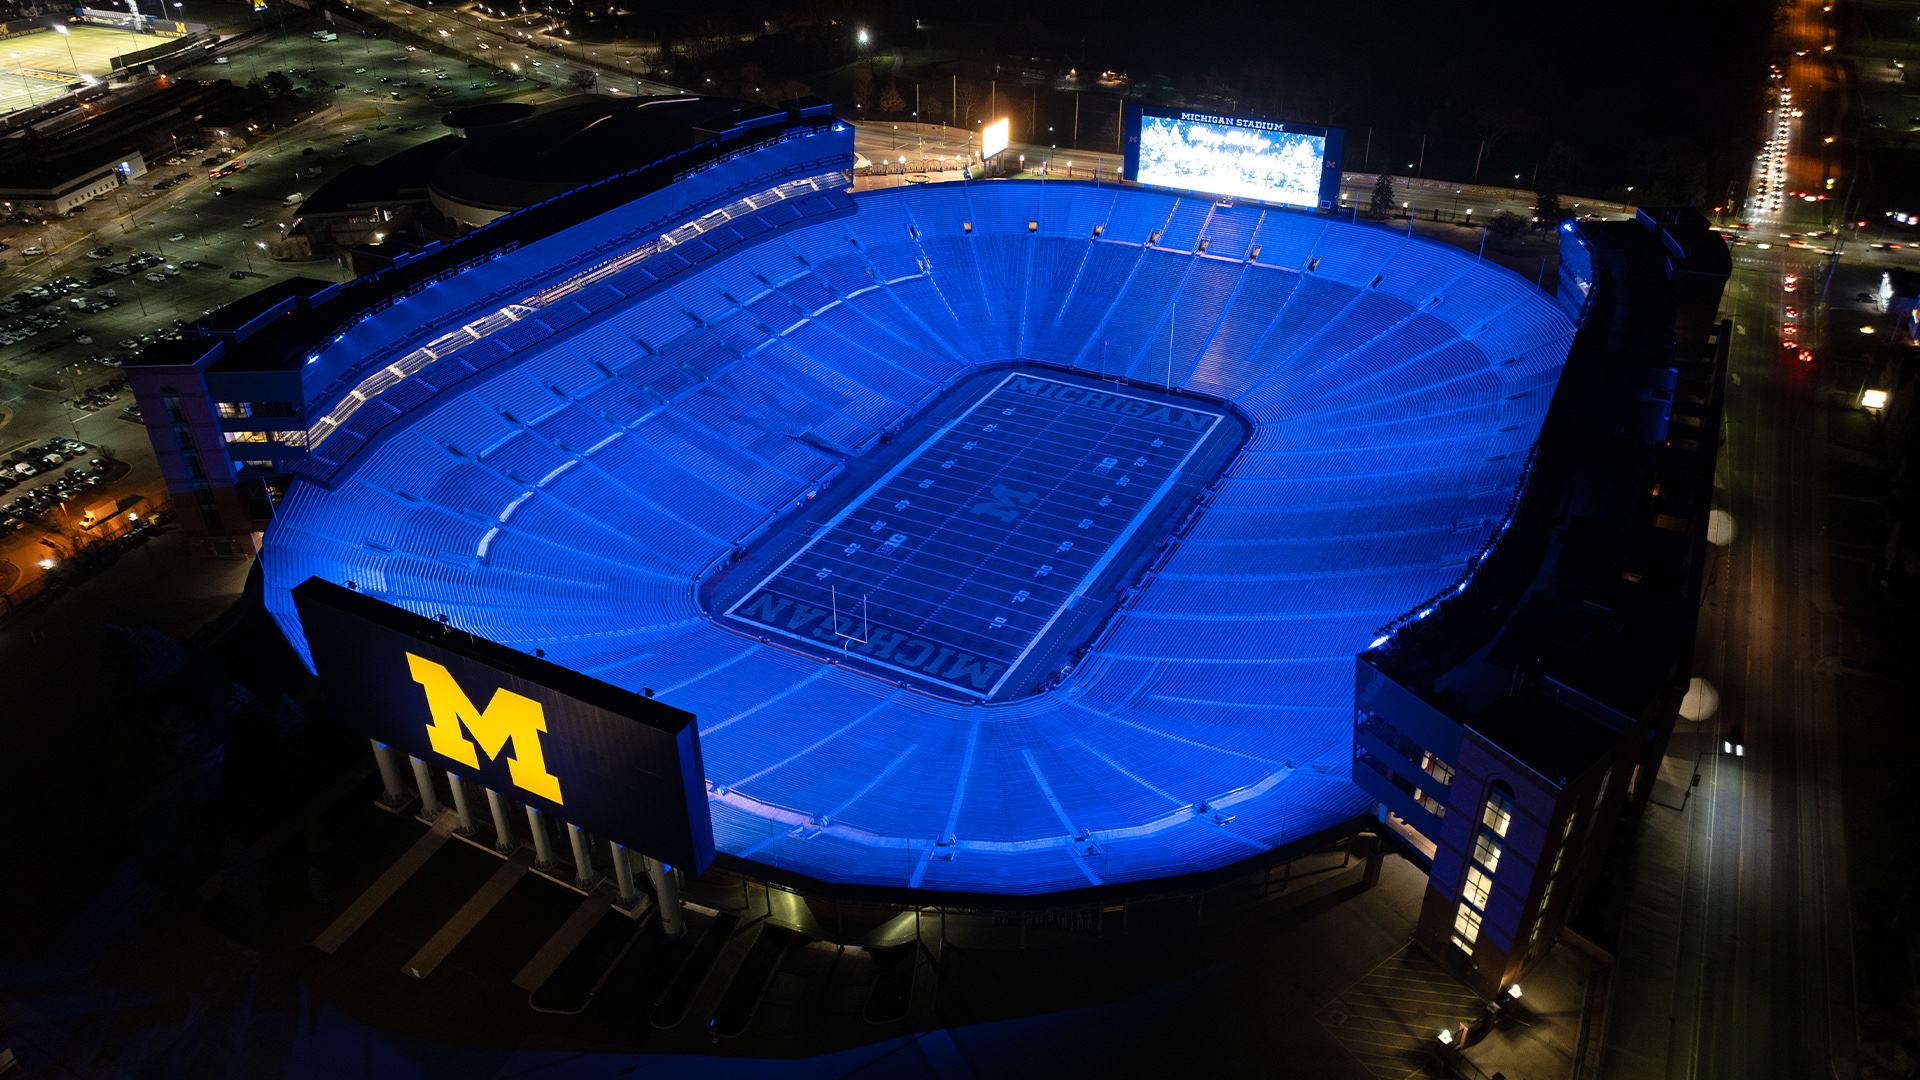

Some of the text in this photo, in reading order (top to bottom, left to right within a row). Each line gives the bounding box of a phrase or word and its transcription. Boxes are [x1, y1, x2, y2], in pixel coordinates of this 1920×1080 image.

[175, 21, 187, 33] M
[1181, 112, 1284, 132] MICHIGAN STADIUM
[1129, 135, 1138, 143] M
[1325, 160, 1336, 169] M
[1006, 377, 1213, 430] MICHIGAN
[969, 483, 1039, 523] M
[1078, 518, 1094, 529] 50
[739, 593, 1003, 690] MICHIGAN
[405, 651, 563, 806] M
